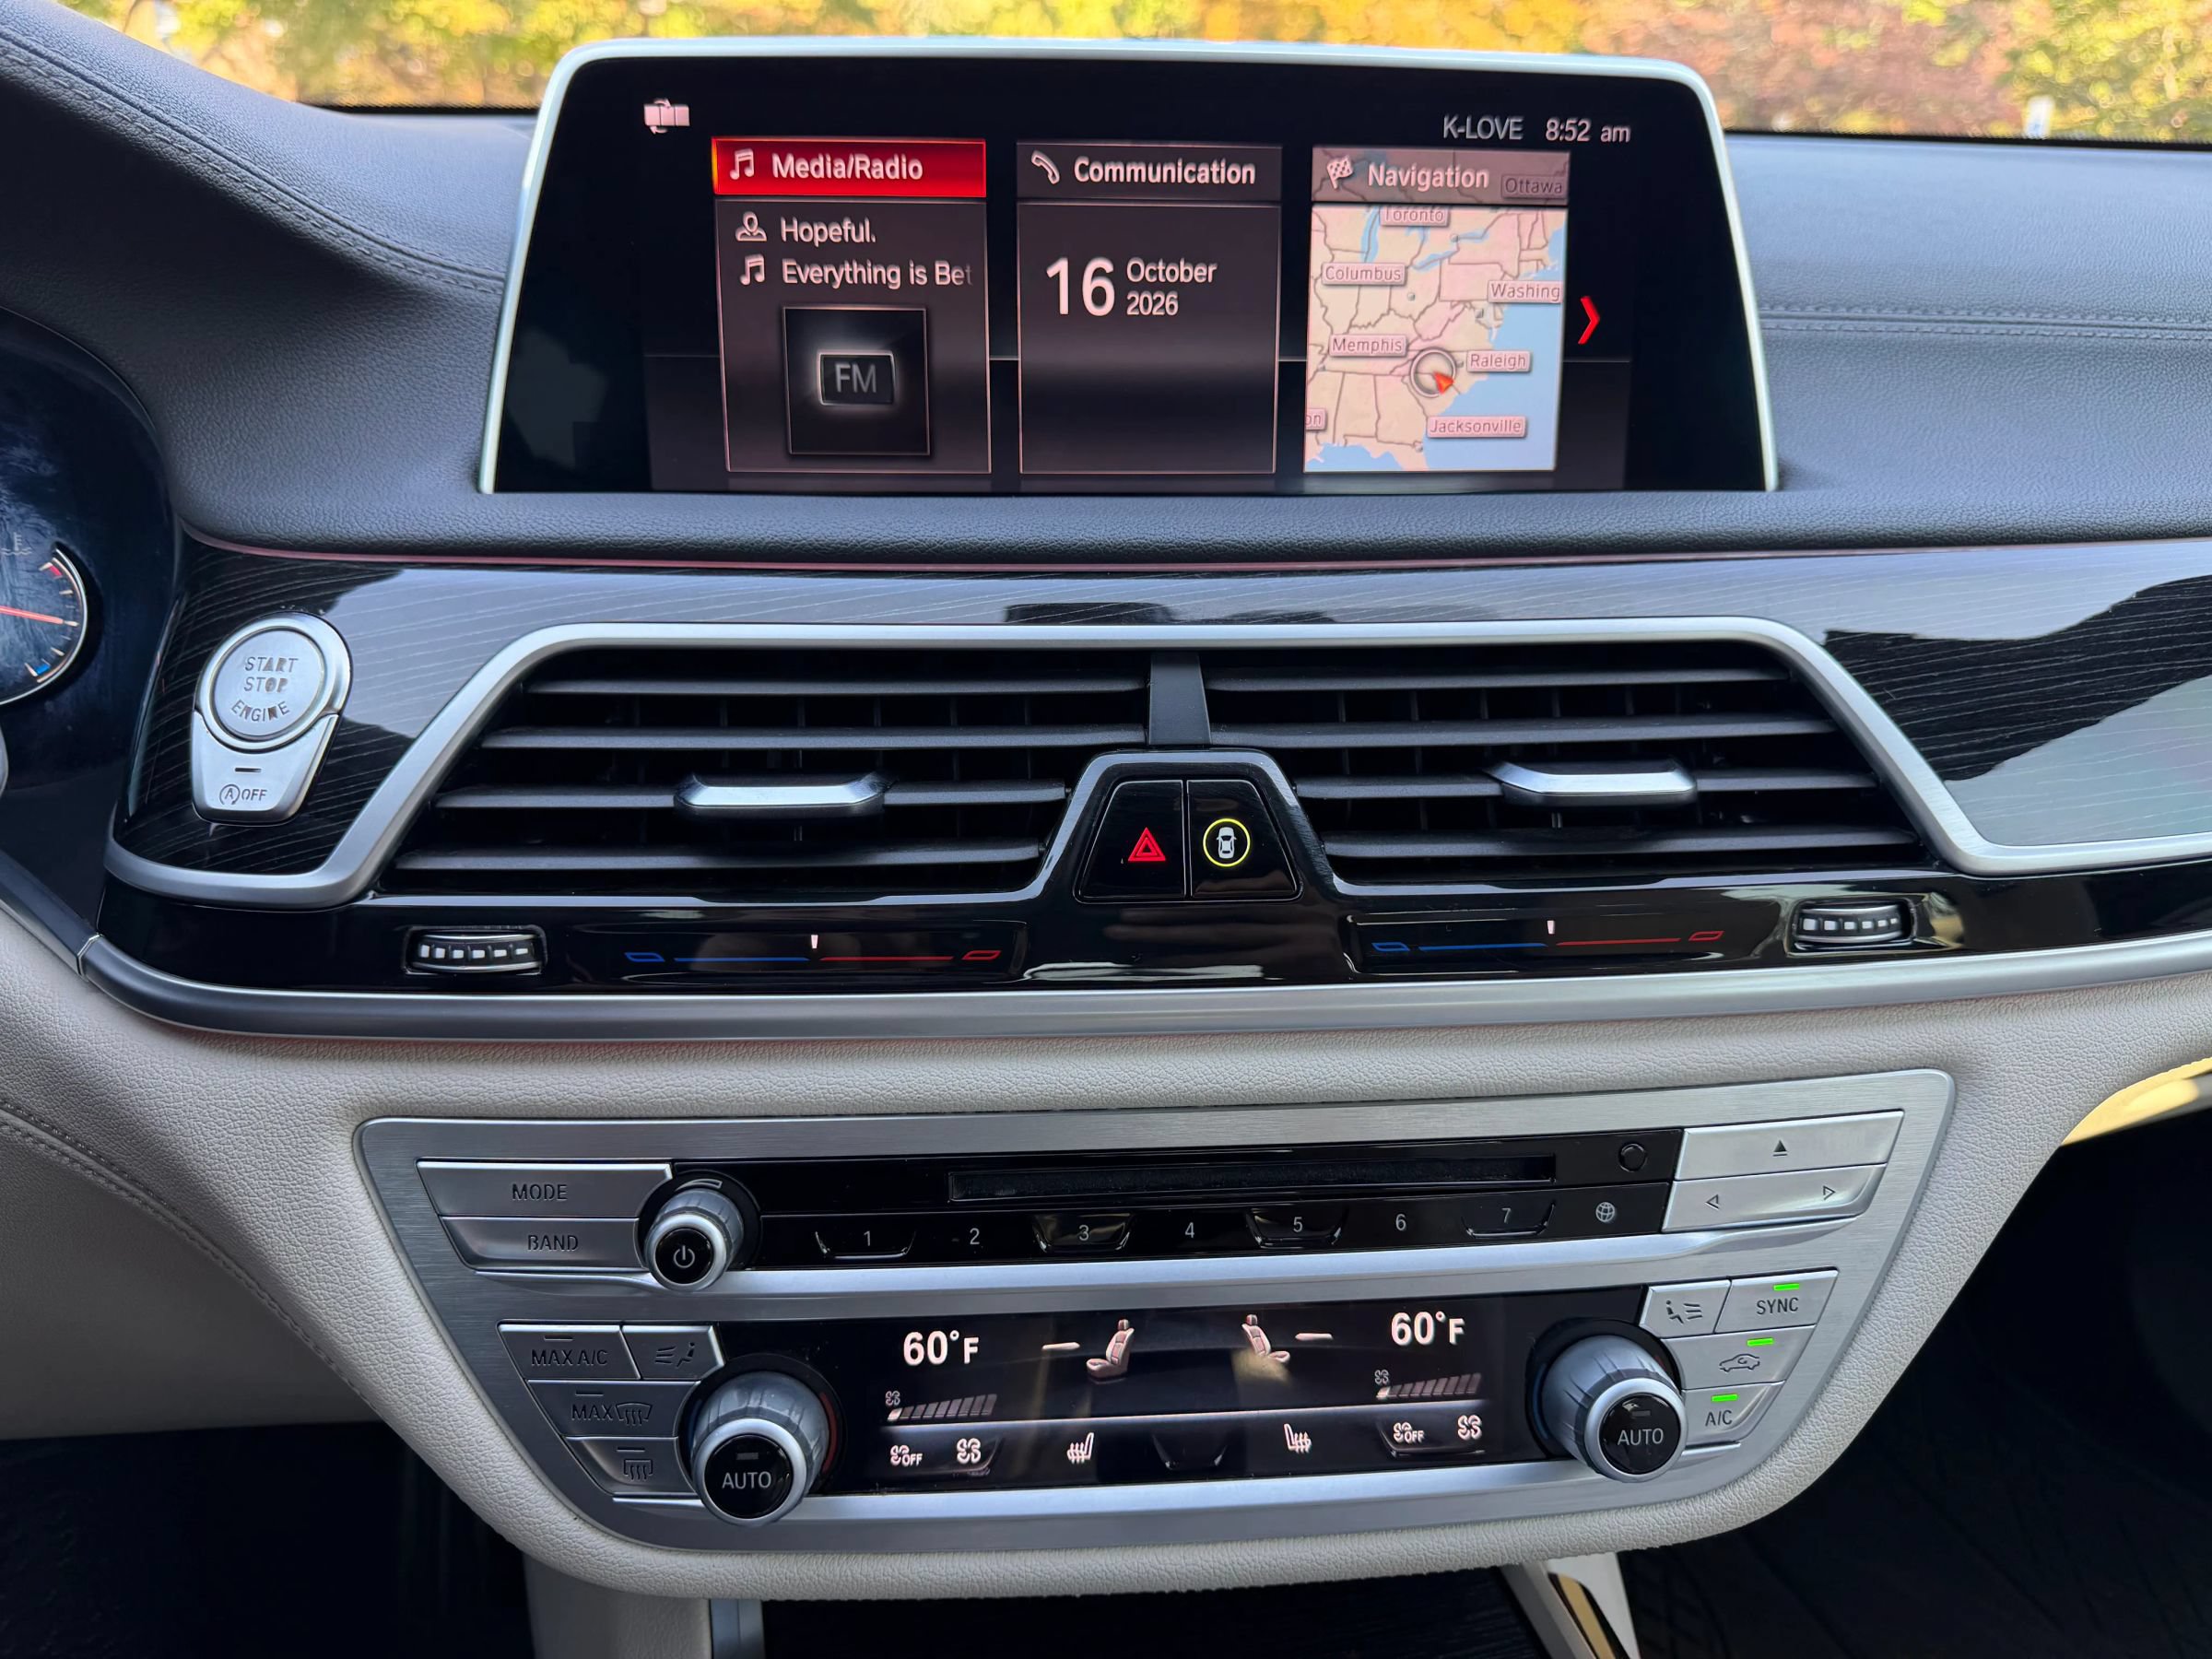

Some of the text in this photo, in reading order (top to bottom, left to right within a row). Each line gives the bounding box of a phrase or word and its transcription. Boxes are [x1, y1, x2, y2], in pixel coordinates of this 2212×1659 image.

[1442, 115, 1524, 140] K-LOVE
[1545, 118, 1631, 143] 8:52 am
[771, 153, 924, 180] Media/Radio
[1074, 156, 1256, 184] Communication
[1367, 162, 1489, 193] Navigation
[1504, 177, 1562, 194] Ottawa
[781, 217, 877, 247] Hopeful.
[782, 258, 973, 289] Everything is Bet
[1324, 265, 1402, 281] Columbus
[1046, 257, 1218, 316] 16 October
[1490, 283, 1560, 301] Washing
[1126, 290, 1179, 316] 2026
[1332, 337, 1402, 356] Memphis
[1469, 353, 1526, 371] Raleigh
[835, 362, 877, 393] FM
[1430, 418, 1522, 434] Jacksonville
[244, 656, 299, 673] START
[243, 677, 288, 693] STOP
[231, 700, 290, 723] ENGINE
[241, 788, 267, 801] OFF
[512, 1183, 569, 1202] MODE
[1293, 1217, 1303, 1232] 5
[1395, 1214, 1406, 1231] 6
[1501, 1207, 1512, 1224] 7
[863, 1230, 871, 1246] 1
[970, 1228, 980, 1245] 2
[1078, 1224, 1090, 1241] 3
[1184, 1222, 1195, 1239] 4
[527, 1234, 579, 1252] BAND
[1756, 1297, 1799, 1315] SYNC
[1391, 1311, 1465, 1346] 60°F
[903, 1329, 980, 1366] 60°F
[531, 1349, 608, 1366] MAX A/C
[571, 1404, 614, 1421] MAX
[1705, 1409, 1733, 1427] A/C
[1404, 1429, 1424, 1443] OFF
[1617, 1428, 1664, 1446] AUTO
[902, 1453, 923, 1467] OFF
[722, 1471, 772, 1489] AUTO
